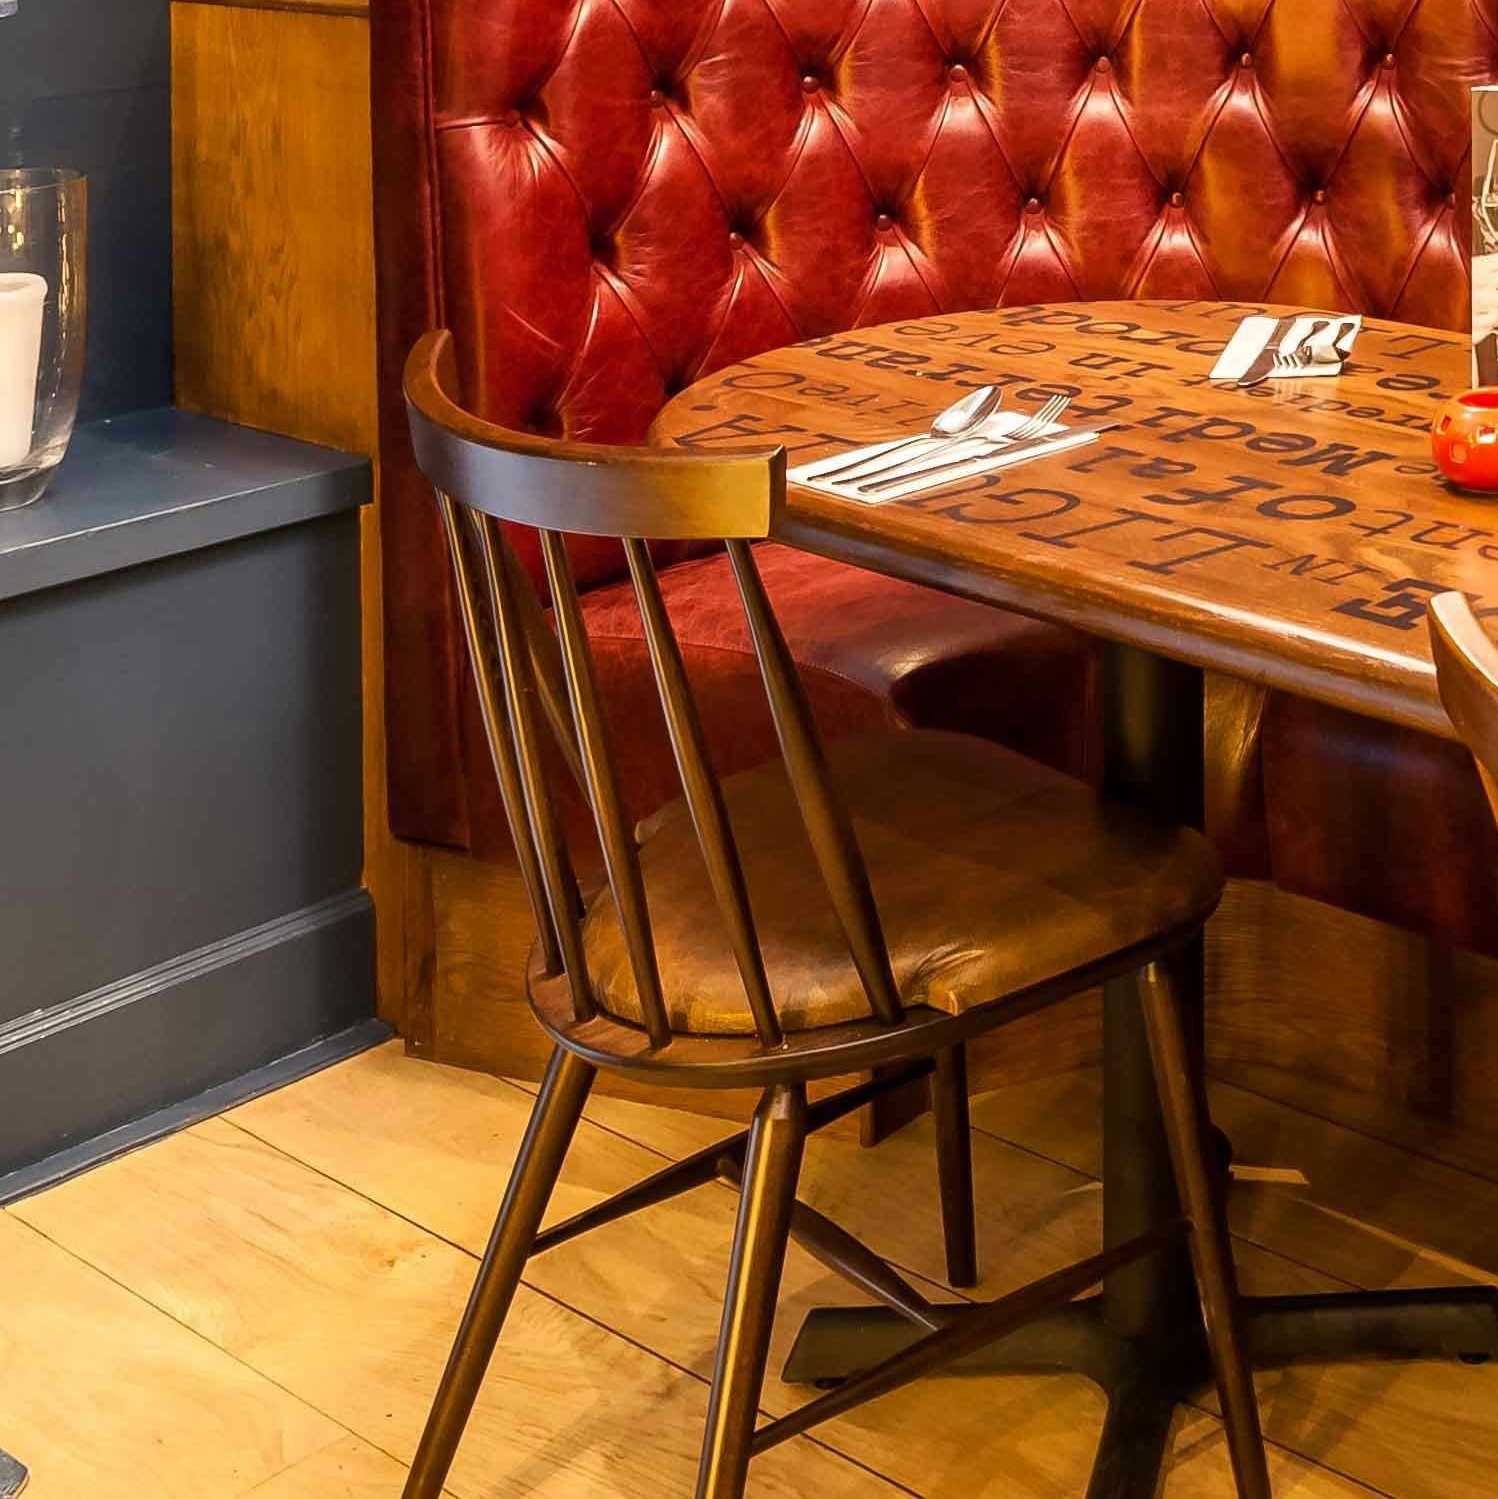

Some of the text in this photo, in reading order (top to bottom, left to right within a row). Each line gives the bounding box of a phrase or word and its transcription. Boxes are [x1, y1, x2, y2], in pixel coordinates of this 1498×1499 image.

[1068, 352, 1174, 382] in
[1143, 475, 1357, 522] of
[1262, 554, 1377, 587] IN
